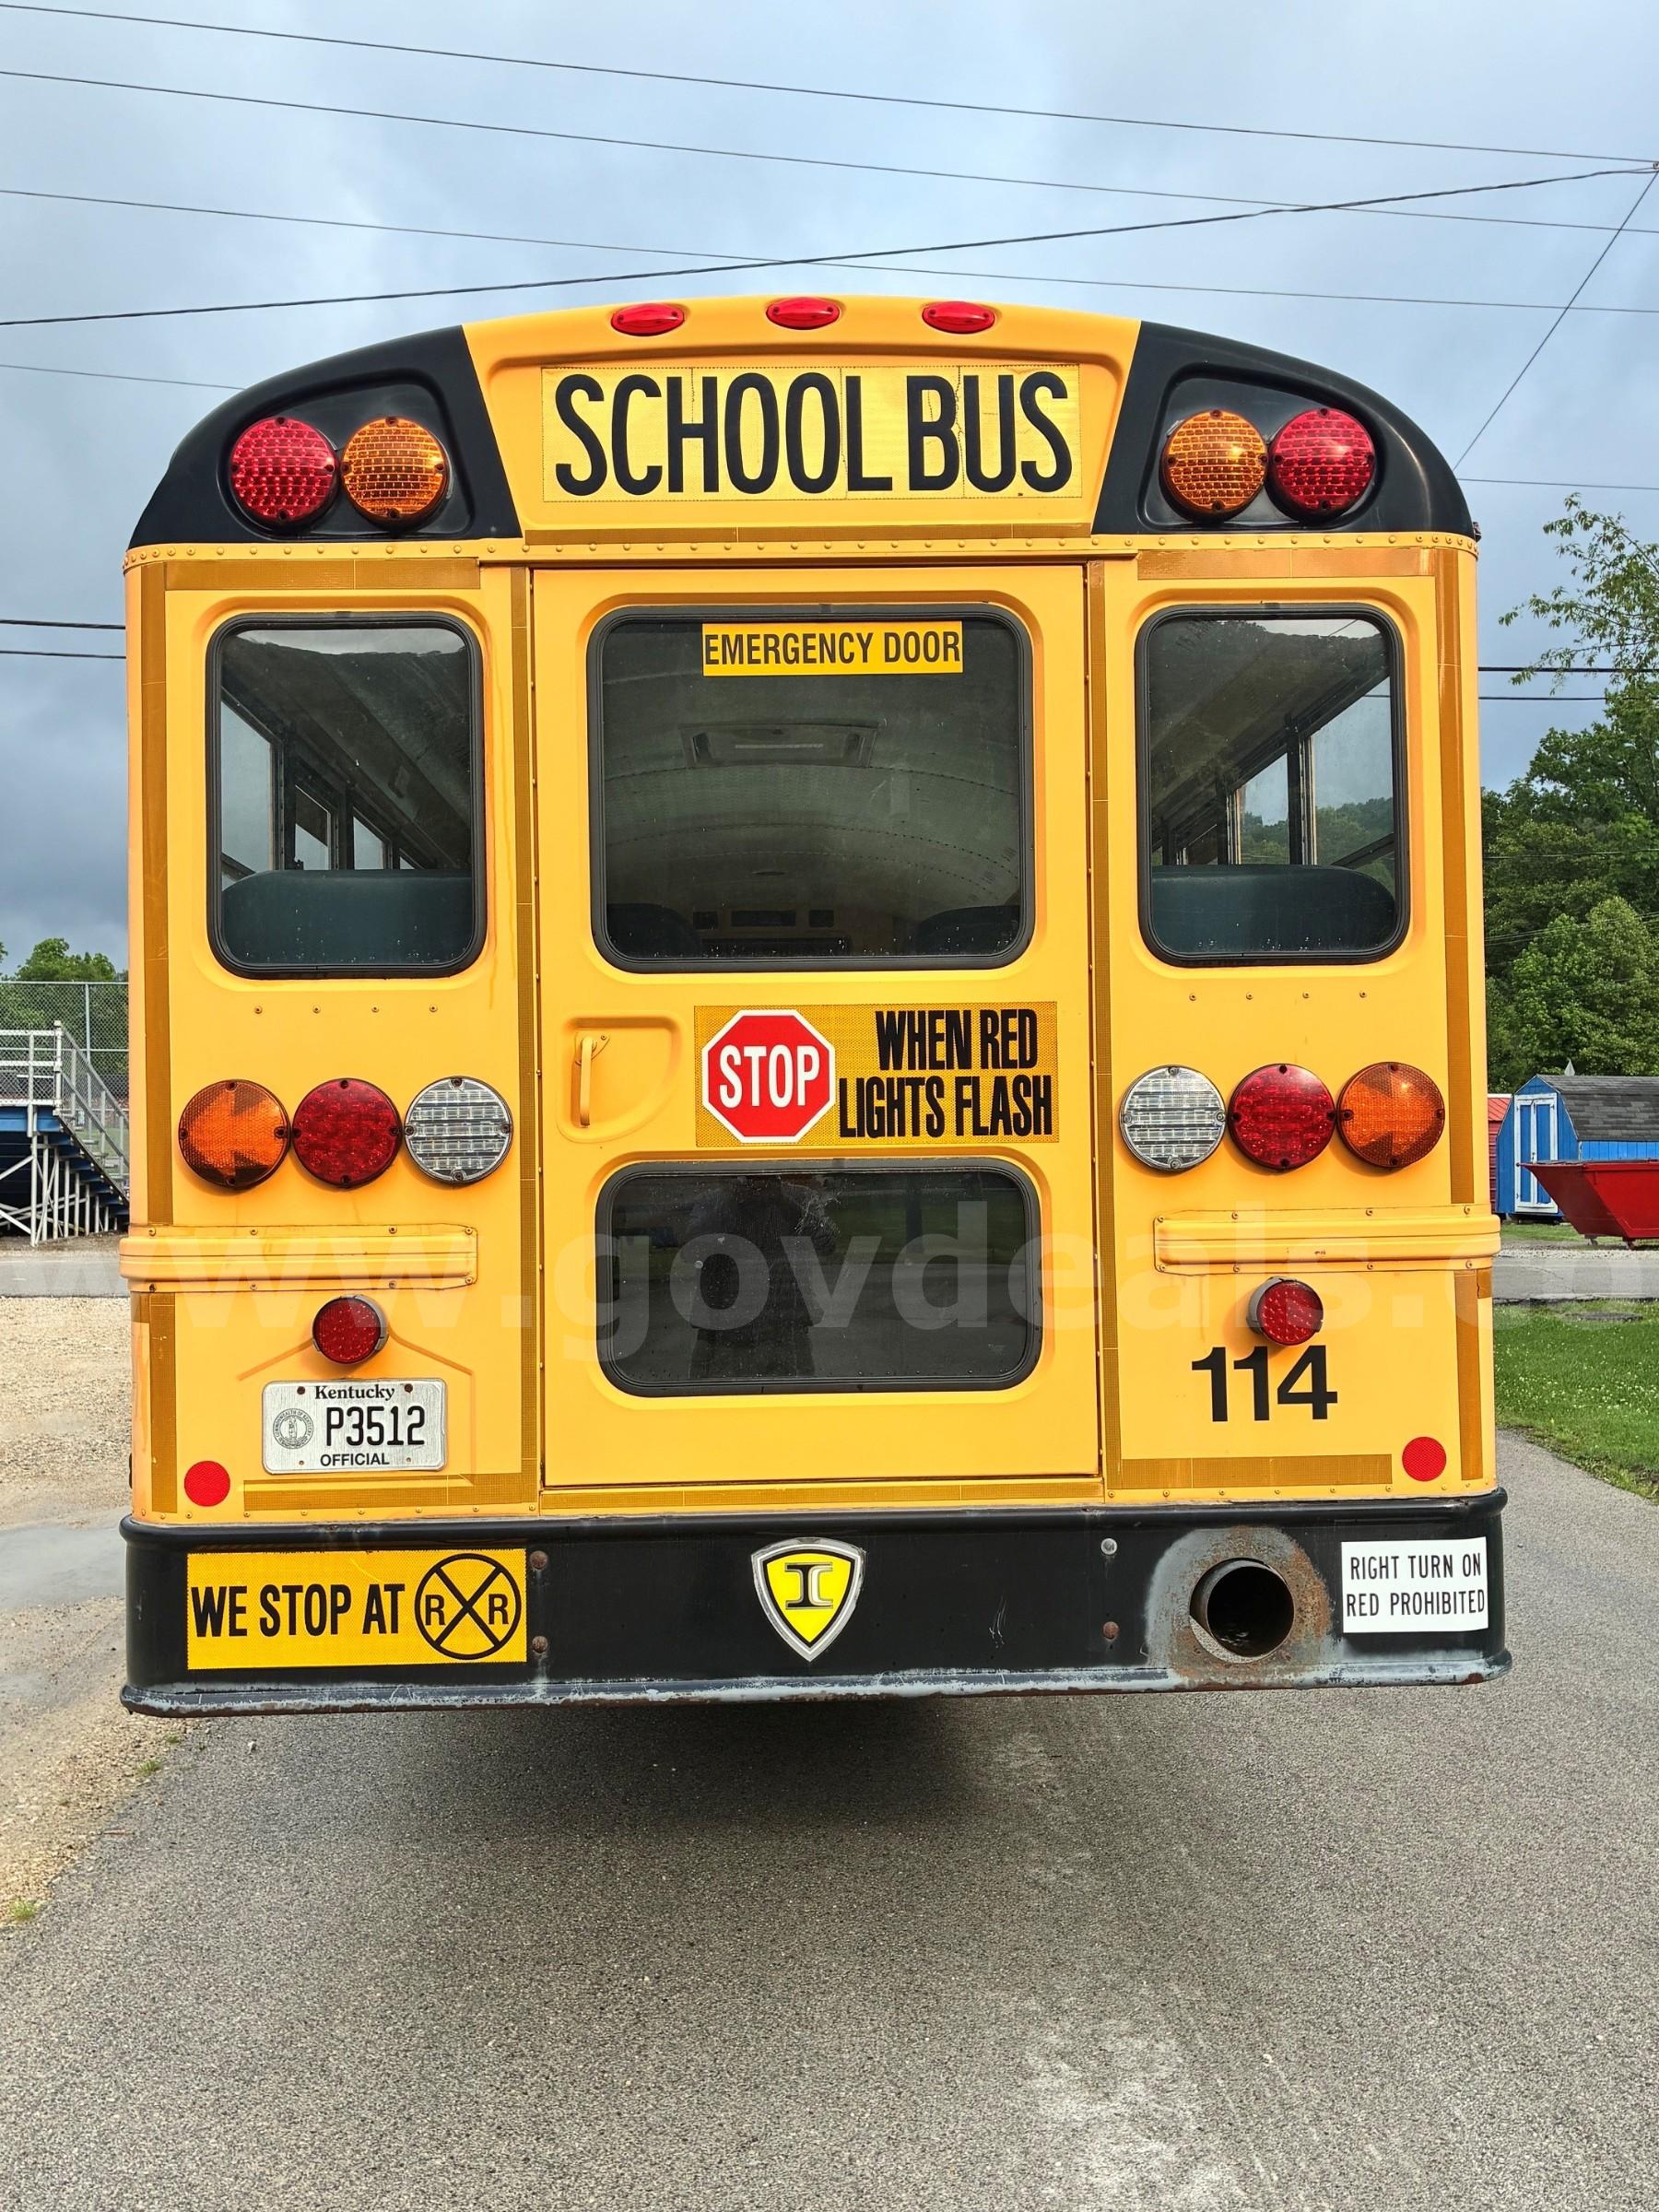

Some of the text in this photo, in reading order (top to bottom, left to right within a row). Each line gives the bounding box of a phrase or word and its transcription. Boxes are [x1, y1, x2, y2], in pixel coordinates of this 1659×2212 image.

[554, 371, 1073, 496] SCHOOL BUS
[705, 630, 961, 665] EMERGENCY DOOR
[875, 1008, 1039, 1071] WHEN RED
[718, 1044, 820, 1108] STOP
[838, 1074, 1053, 1139] LIGHTS FLASH
[314, 1383, 395, 1402] Kentucky
[1191, 1344, 1338, 1422] 114
[325, 1405, 426, 1447] P3512
[320, 1452, 391, 1467] OFFICIAL
[1350, 1552, 1481, 1581] RIGHT TURN ON
[191, 1585, 248, 1638] WE
[259, 1583, 352, 1638] STOP
[361, 1583, 406, 1634] AT
[1346, 1589, 1486, 1618] RED PROHIBITED
